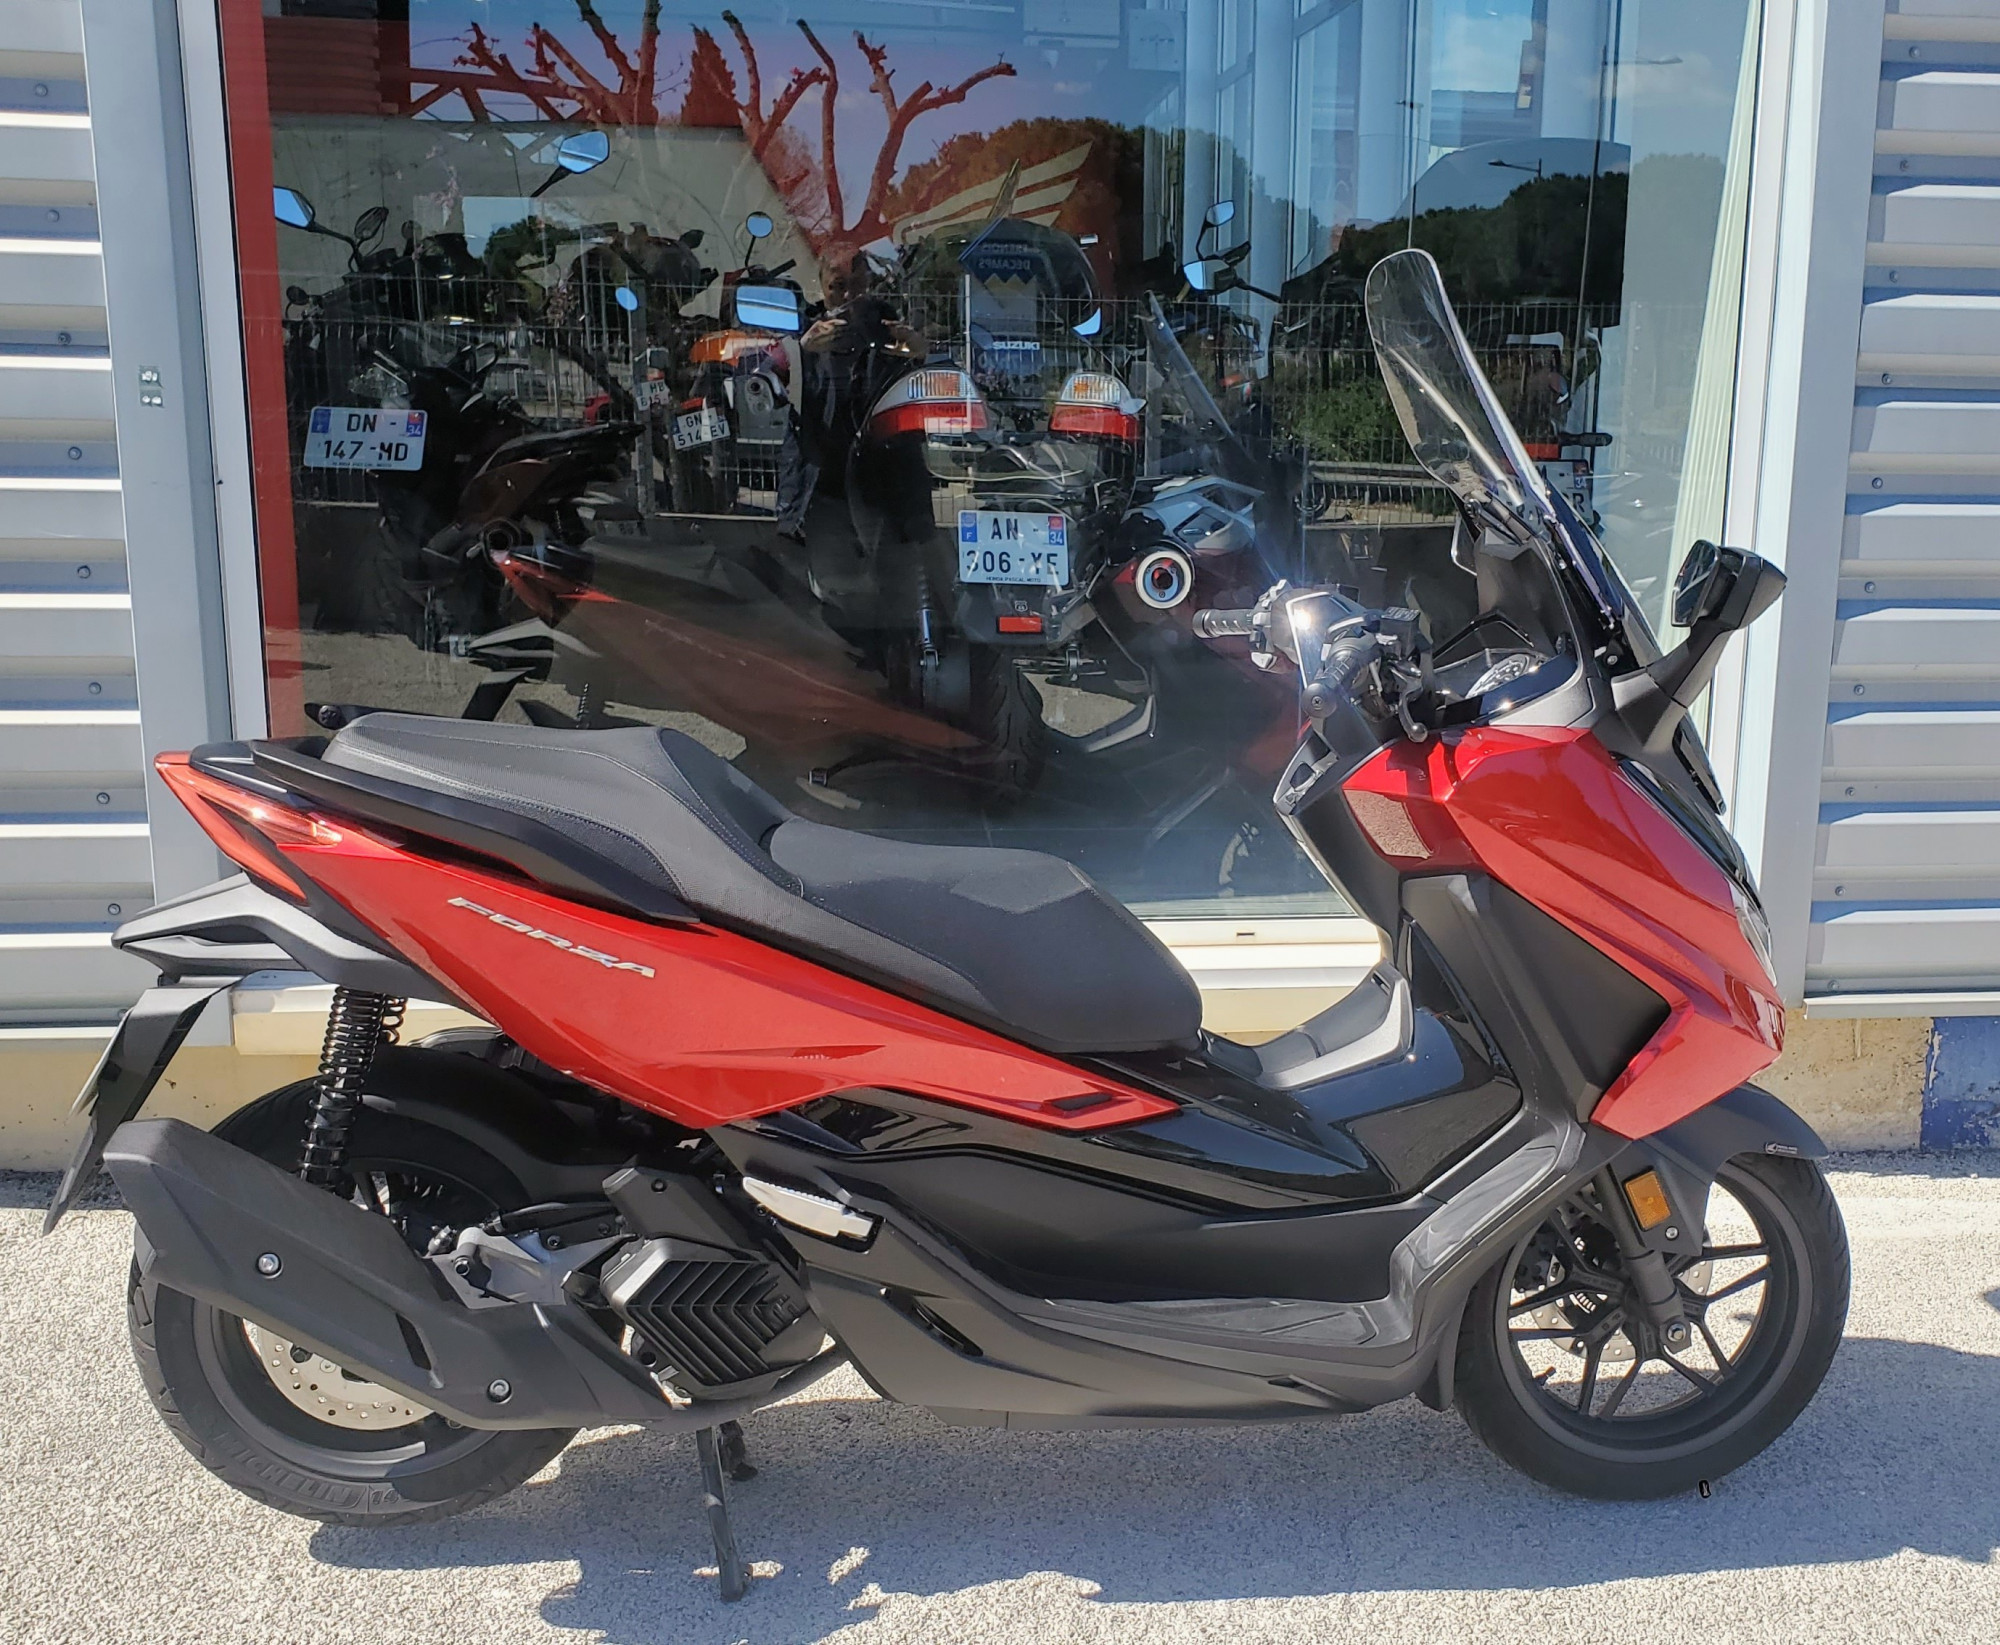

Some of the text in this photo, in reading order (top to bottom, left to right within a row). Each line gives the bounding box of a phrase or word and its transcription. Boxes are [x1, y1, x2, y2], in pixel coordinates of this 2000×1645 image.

[992, 341, 1040, 350] SUZUKI
[347, 413, 377, 432] DN
[408, 425, 421, 435] 34
[991, 518, 1018, 540] AN
[1050, 532, 1063, 544] 34
[448, 897, 655, 978] FORZA
[214, 1432, 354, 1504] MICHELIN
